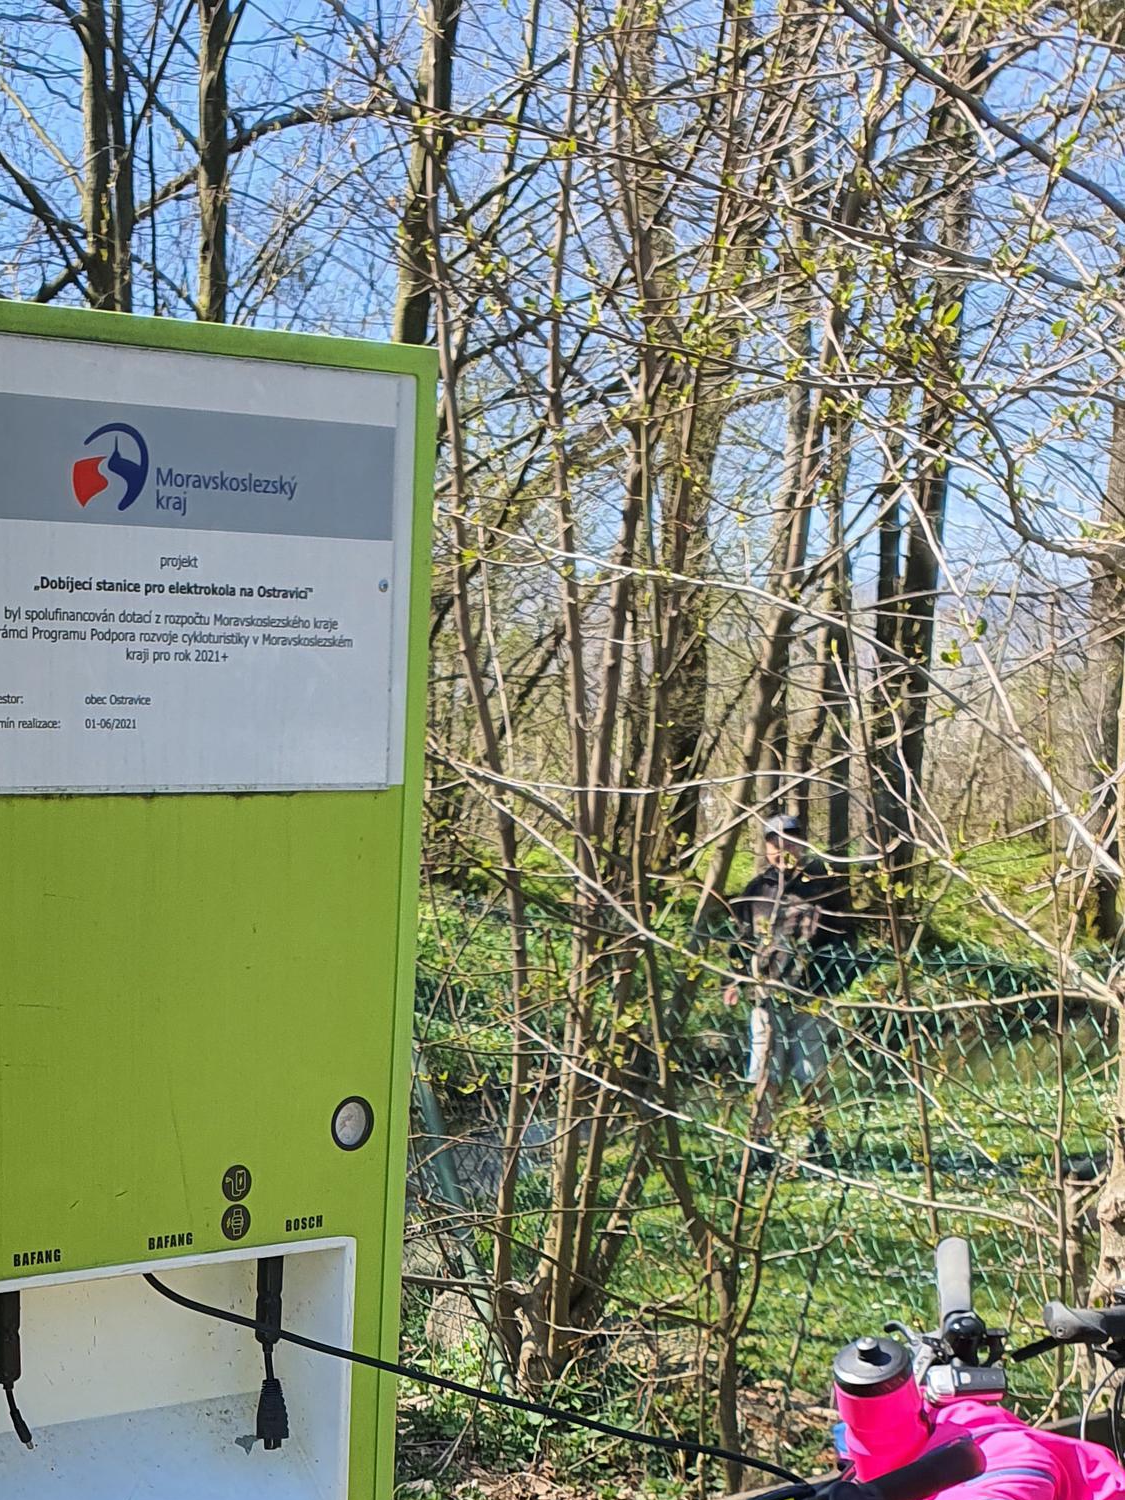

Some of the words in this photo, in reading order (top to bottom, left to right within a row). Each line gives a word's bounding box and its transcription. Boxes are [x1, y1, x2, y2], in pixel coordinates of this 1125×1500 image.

[156, 467, 298, 500] Moravskoslezský
[156, 490, 187, 516] kraj
[160, 555, 198, 570] projekt
[96, 579, 140, 593] stanice
[145, 583, 165, 596] pro
[168, 582, 236, 597] elektrokola
[240, 587, 254, 597] na
[4, 606, 21, 622] byl
[25, 608, 115, 624] spolufinancován
[118, 609, 152, 624] dotací
[155, 615, 161, 624] z
[164, 612, 210, 627] rozpočtu
[213, 613, 310, 629] Moravskoslezského
[313, 617, 339, 630] kraje
[32, 627, 86, 643] Programu
[90, 628, 135, 644] Podpora
[139, 630, 178, 646] rozvoje
[181, 632, 250, 648] cykloturistiky
[252, 636, 259, 646] v
[262, 633, 353, 648] Moravskoslezském
[126, 648, 149, 663] kraji
[152, 650, 171, 664] pro
[174, 648, 191, 662] rok
[194, 650, 229, 663] 2021+
[85, 694, 107, 705] obec
[109, 695, 151, 706] Ostravice
[18, 718, 61, 729] realizace:
[85, 718, 137, 730] 01-06/2021
[285, 1214, 323, 1233] BOSCH
[148, 1232, 194, 1251] BAFANG
[13, 1248, 62, 1268] BAFANG
